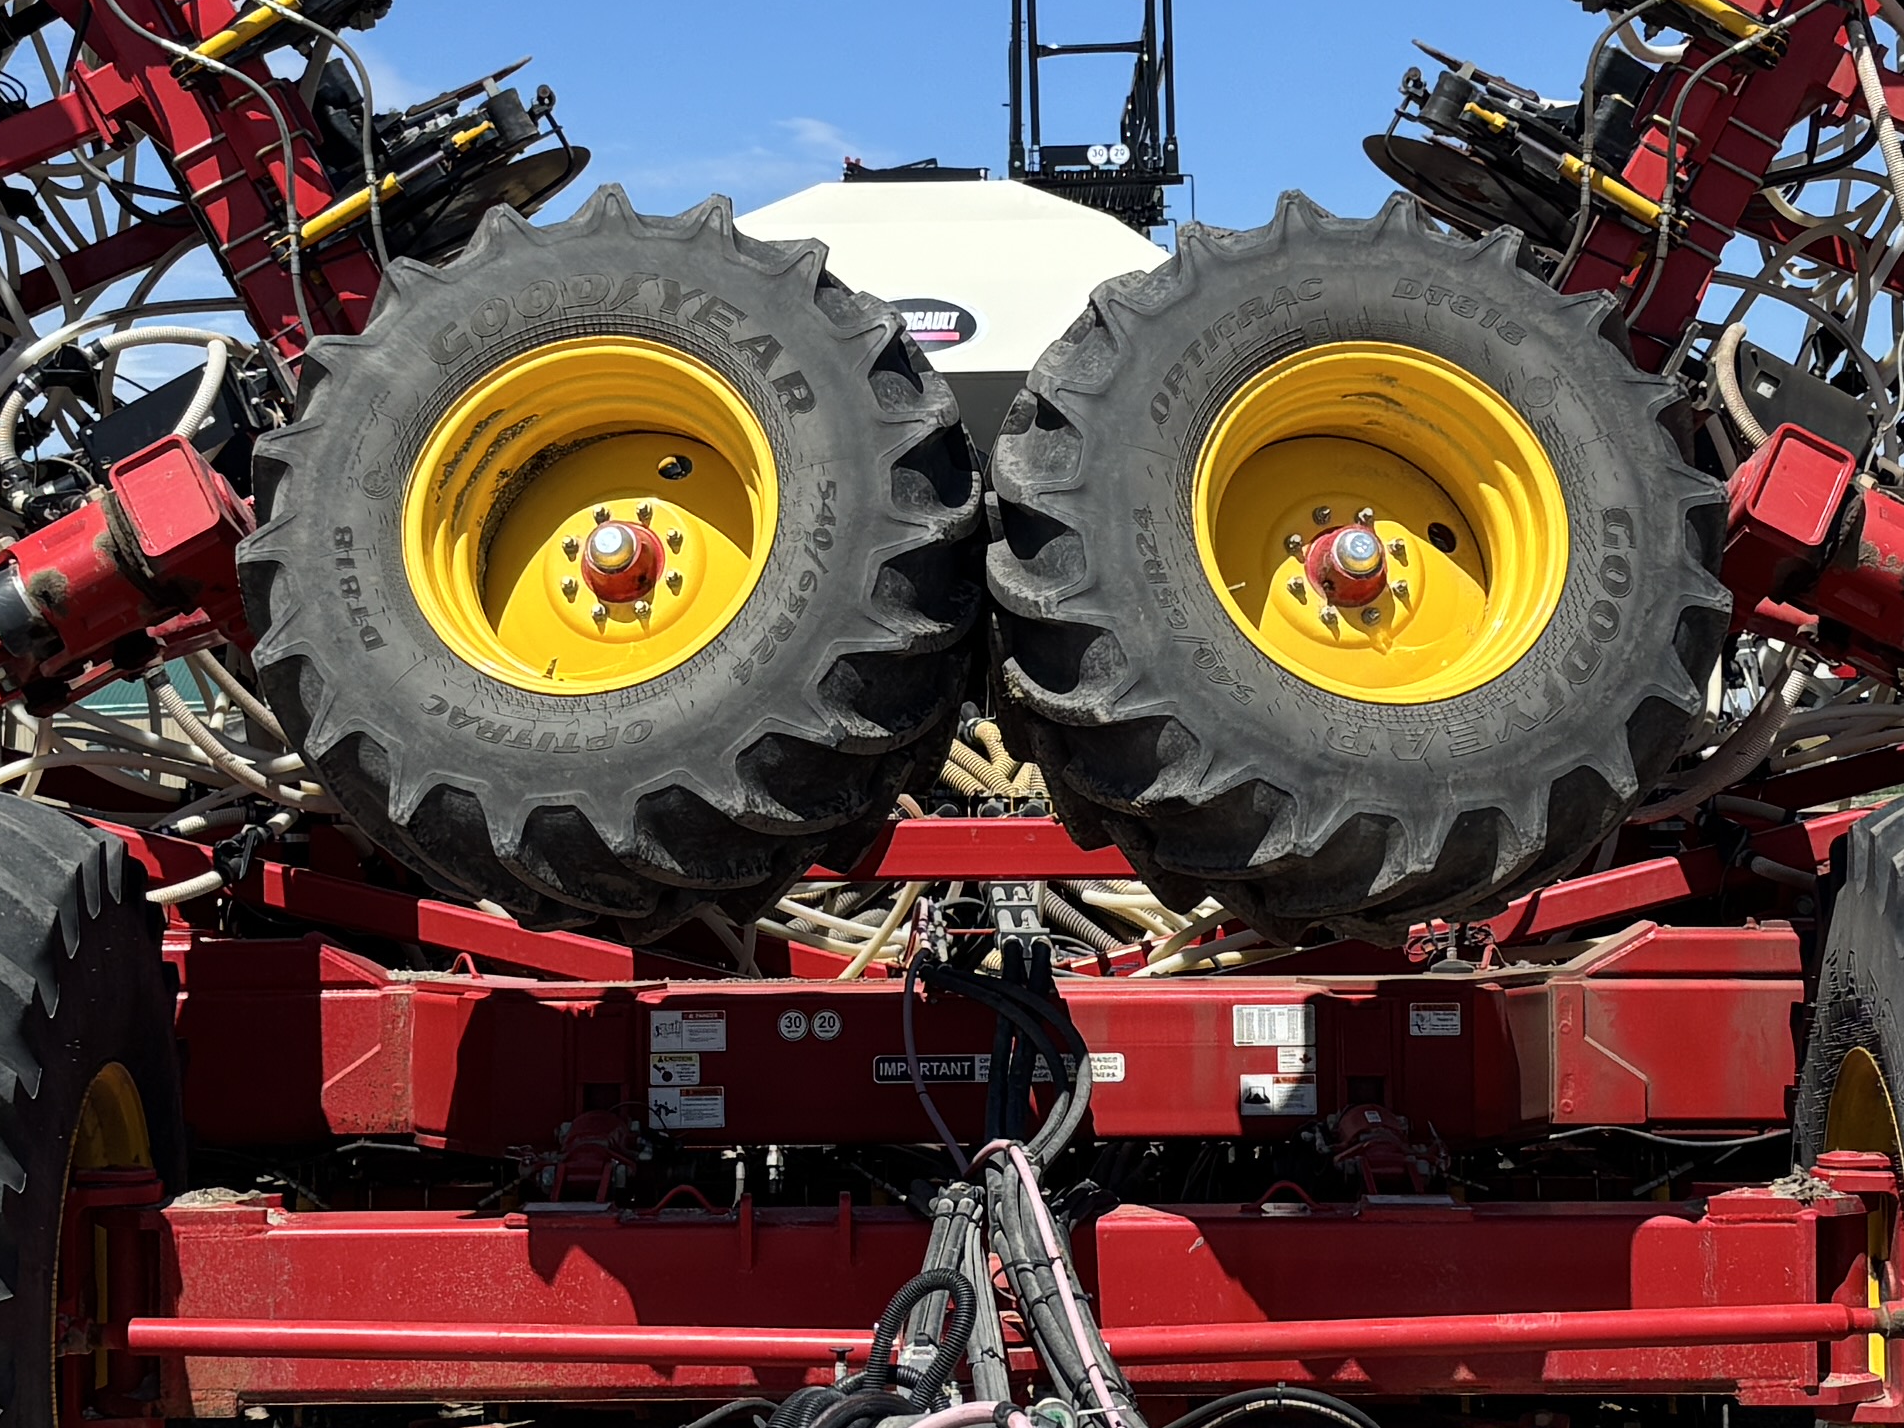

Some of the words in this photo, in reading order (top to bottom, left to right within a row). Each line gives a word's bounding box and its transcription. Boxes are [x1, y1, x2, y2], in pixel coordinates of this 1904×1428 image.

[427, 273, 816, 417] GOODYEAR
[901, 311, 960, 330] RGAULT
[1391, 277, 1528, 347] DT818
[1149, 277, 1323, 425] OPTITRAC
[333, 526, 386, 652] DT818
[730, 480, 837, 684] 540/65R24
[1325, 506, 1636, 762] GOODYEAR
[420, 694, 653, 754] OPTITRAC
[784, 1015, 802, 1029] 30
[818, 1015, 836, 1029] 20
[879, 1061, 972, 1076] IMPRTANT
